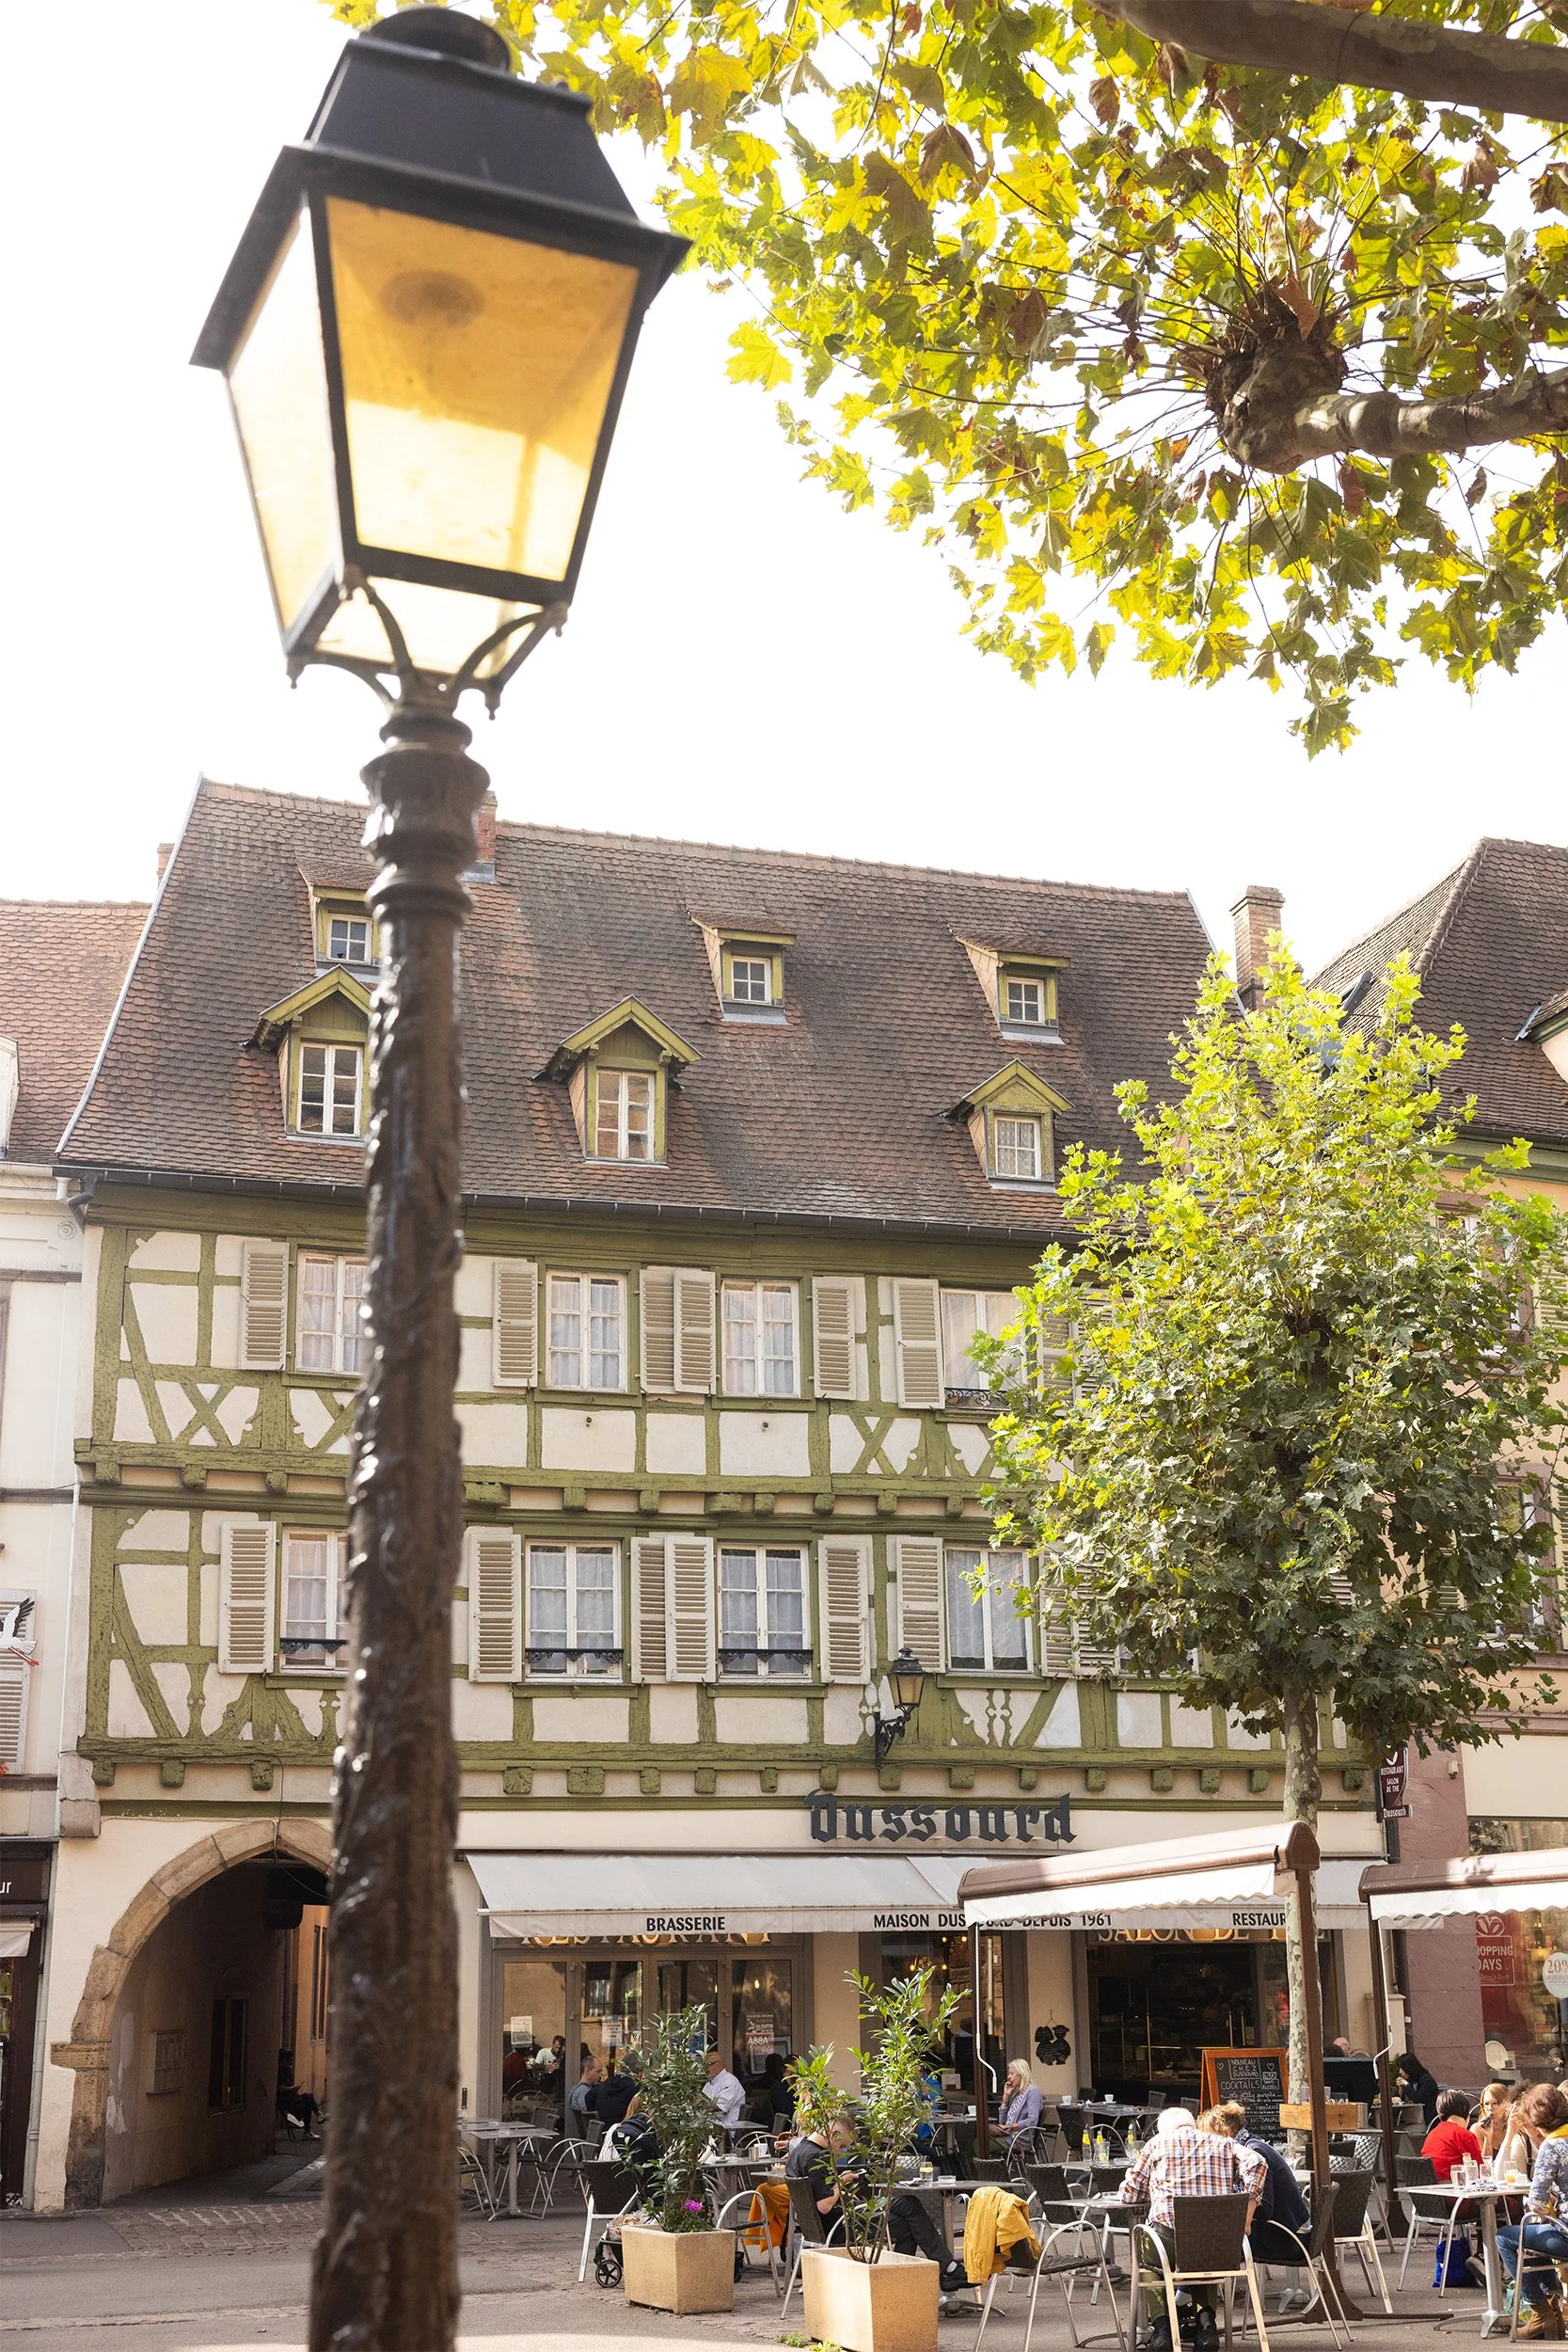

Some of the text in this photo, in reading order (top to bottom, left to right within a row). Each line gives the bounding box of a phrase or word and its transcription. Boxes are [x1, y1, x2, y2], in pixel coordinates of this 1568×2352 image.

[1380, 1765, 1404, 1775] RESTAURANT
[1386, 1777, 1400, 1786] SALON
[803, 1788, 1077, 1843] Dussourd
[1383, 1806, 1406, 1818] Dussourd
[646, 1916, 726, 1931] BRASSERIE
[874, 1914, 929, 1928] MAISON
[1082, 1913, 1112, 1927] 1961
[1232, 1913, 1286, 1926] RESTAUR
[1478, 1946, 1513, 1956] OPPING
[1221, 2080, 1260, 2090] COCKTAILS
